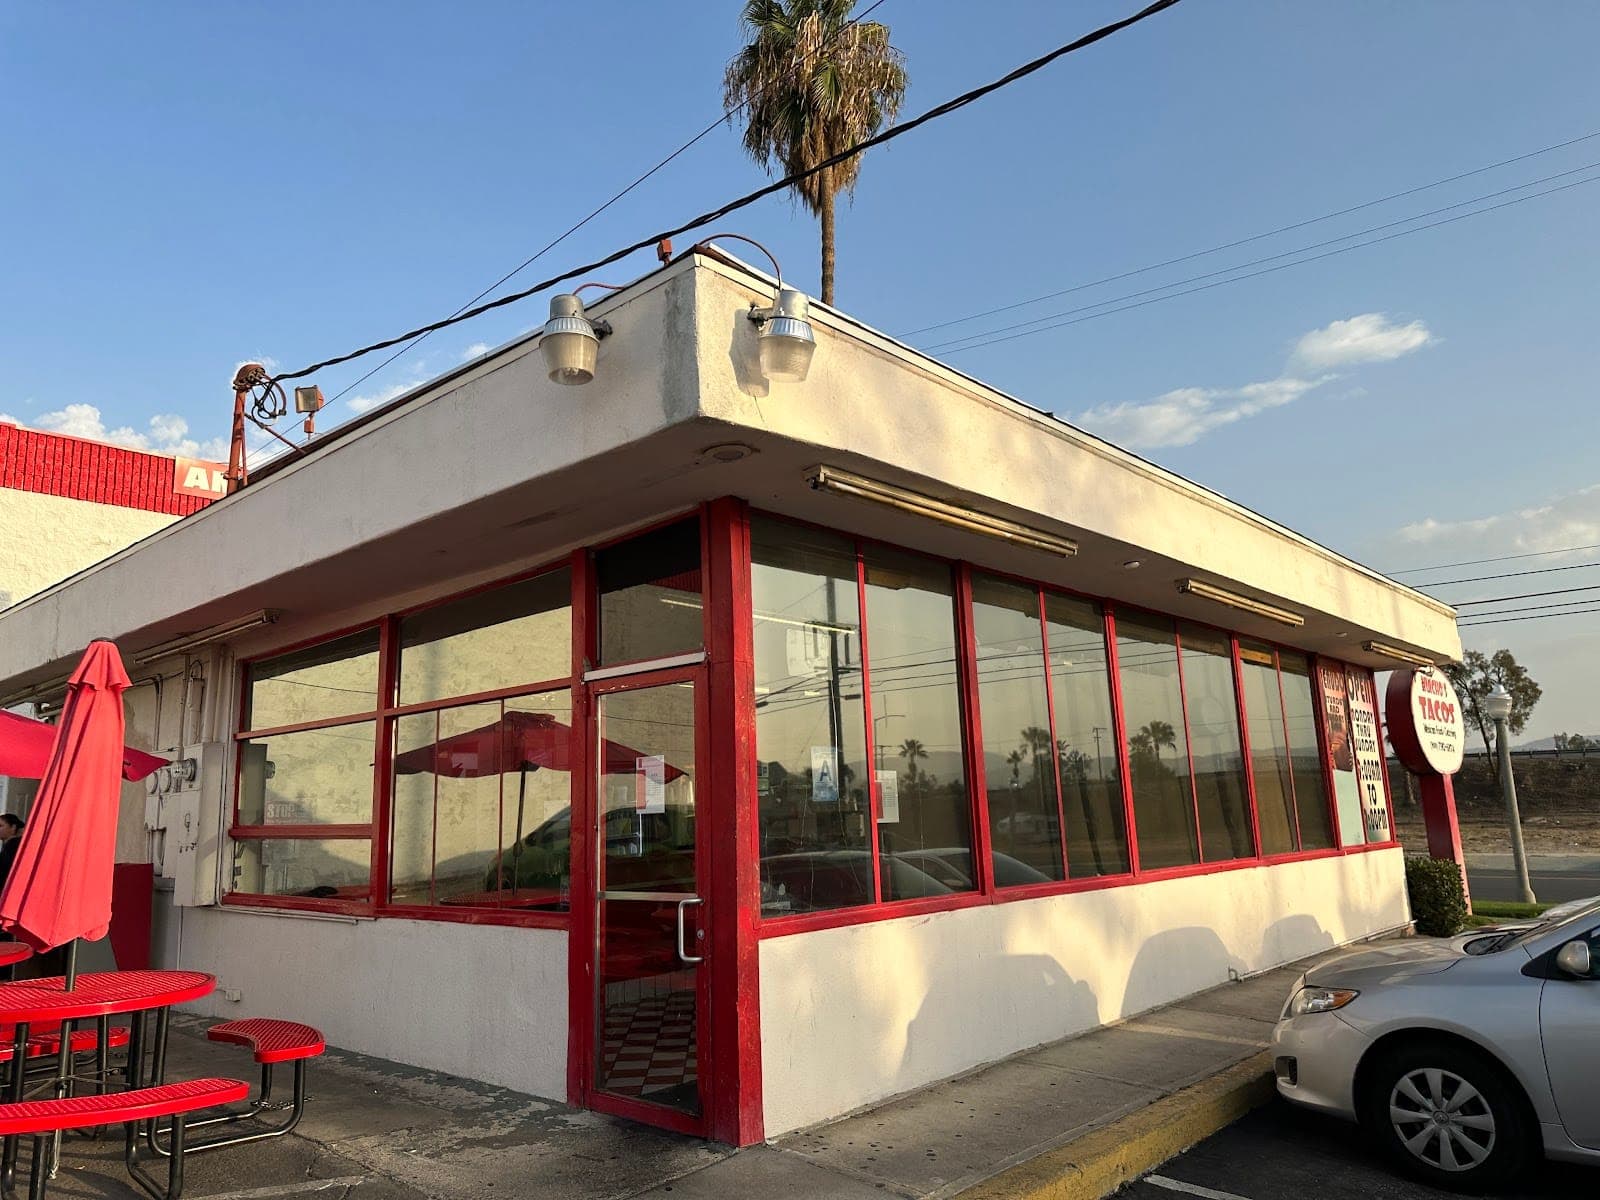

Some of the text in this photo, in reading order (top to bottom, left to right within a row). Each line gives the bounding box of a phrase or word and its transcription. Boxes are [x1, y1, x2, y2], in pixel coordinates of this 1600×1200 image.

[1418, 696, 1455, 724] TACOS
[1356, 722, 1371, 738] THRU
[820, 759, 832, 782] A
[1367, 783, 1377, 806] TO
[267, 803, 296, 818] STOP
